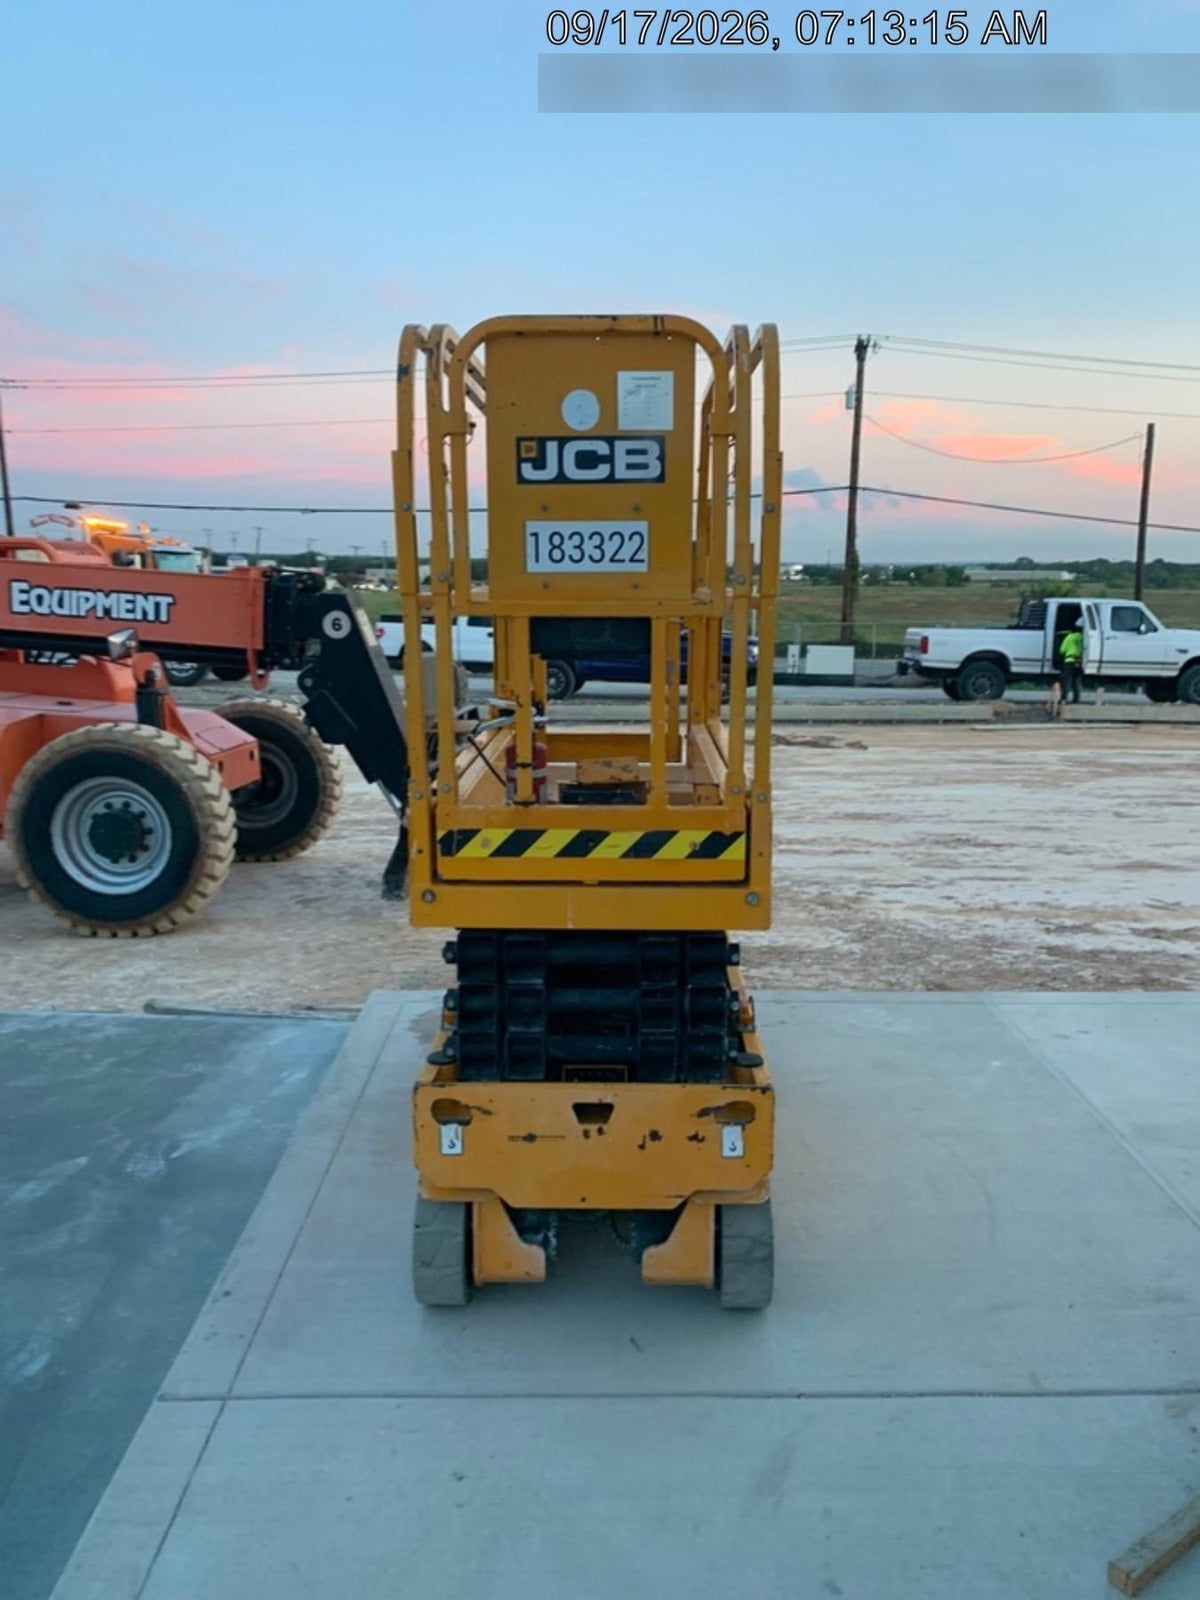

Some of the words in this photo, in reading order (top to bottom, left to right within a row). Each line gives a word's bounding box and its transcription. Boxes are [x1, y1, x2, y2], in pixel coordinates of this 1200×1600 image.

[520, 440, 662, 480] JCB
[529, 531, 646, 563] 183322
[9, 580, 174, 622] EQUIPMENT
